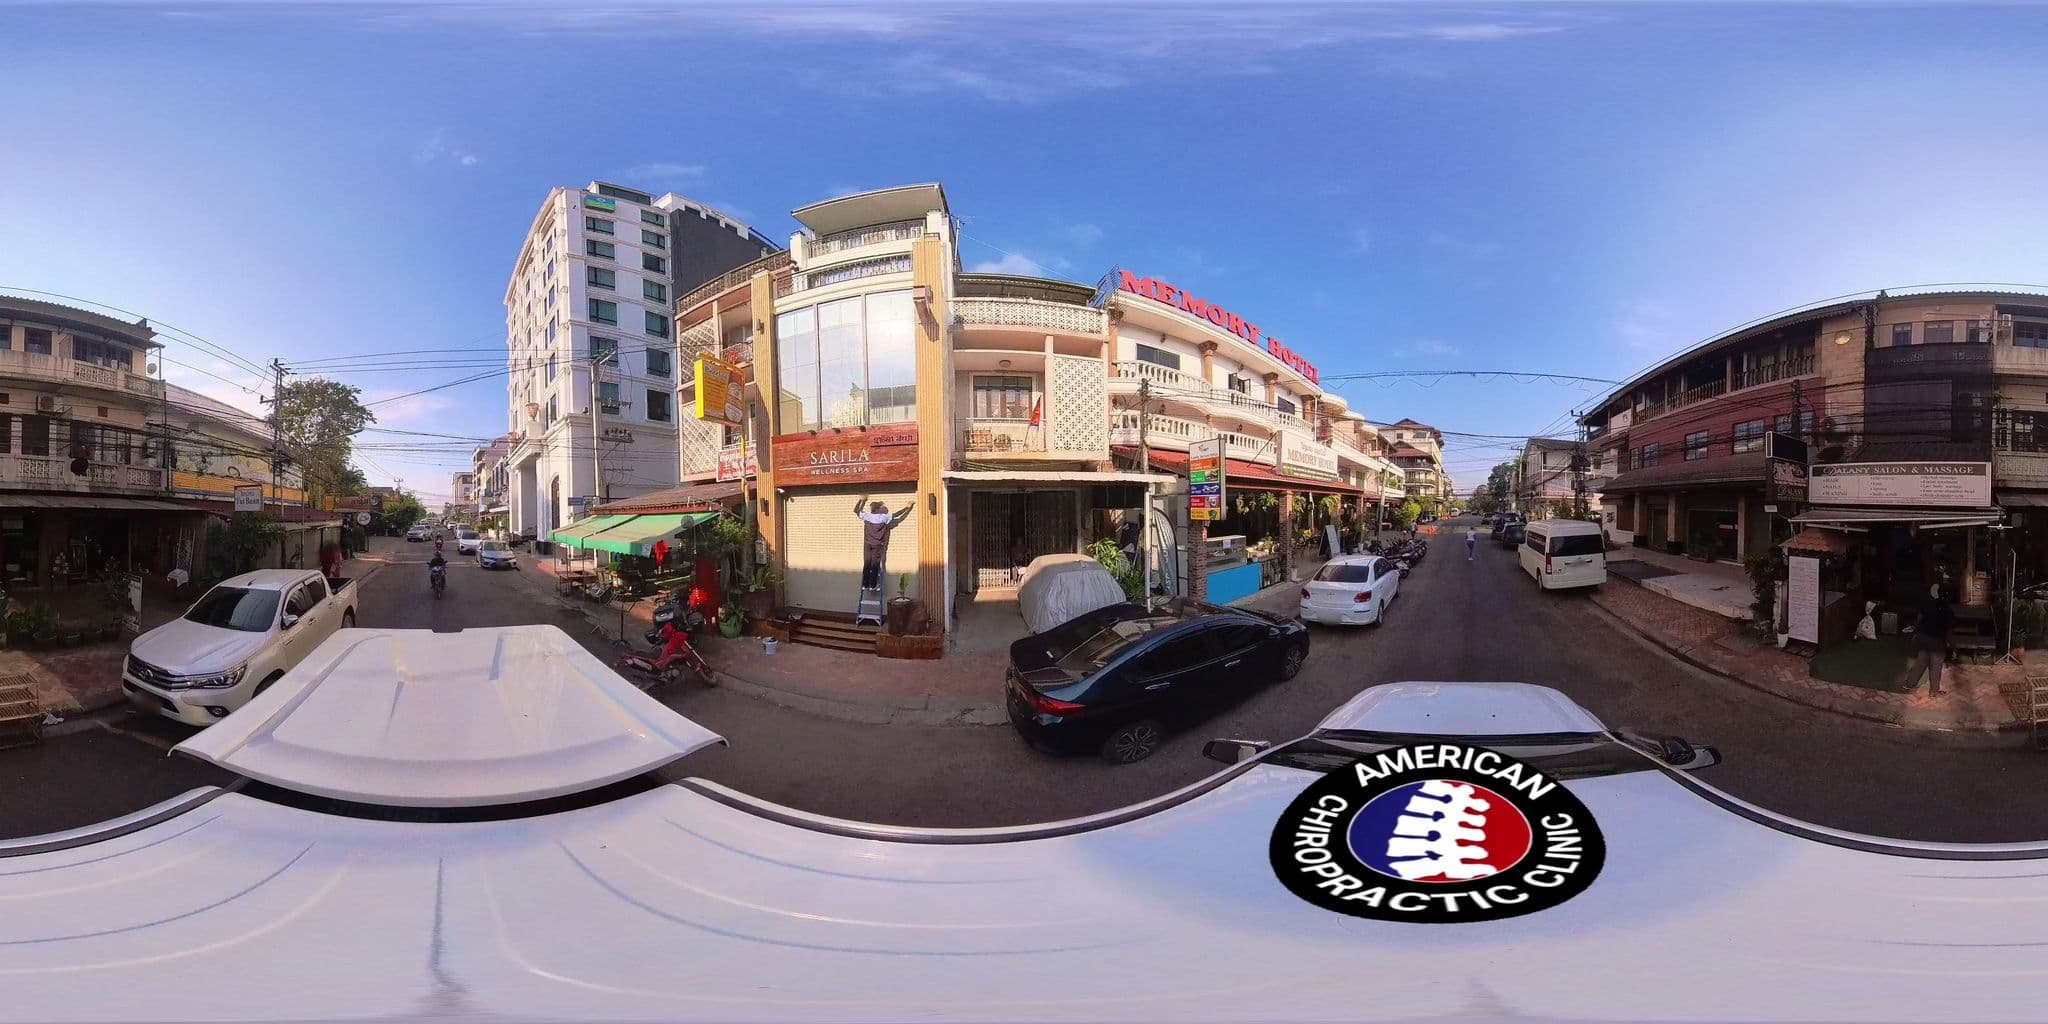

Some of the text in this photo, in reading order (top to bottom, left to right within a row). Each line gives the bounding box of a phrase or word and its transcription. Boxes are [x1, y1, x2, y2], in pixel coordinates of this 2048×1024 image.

[1118, 269, 1320, 386] MEMORY HOTEL
[810, 448, 870, 465] SARILA
[810, 467, 850, 475] WELLNESS
[1911, 466, 1919, 474] &
[1924, 466, 1974, 474] MASSAGE
